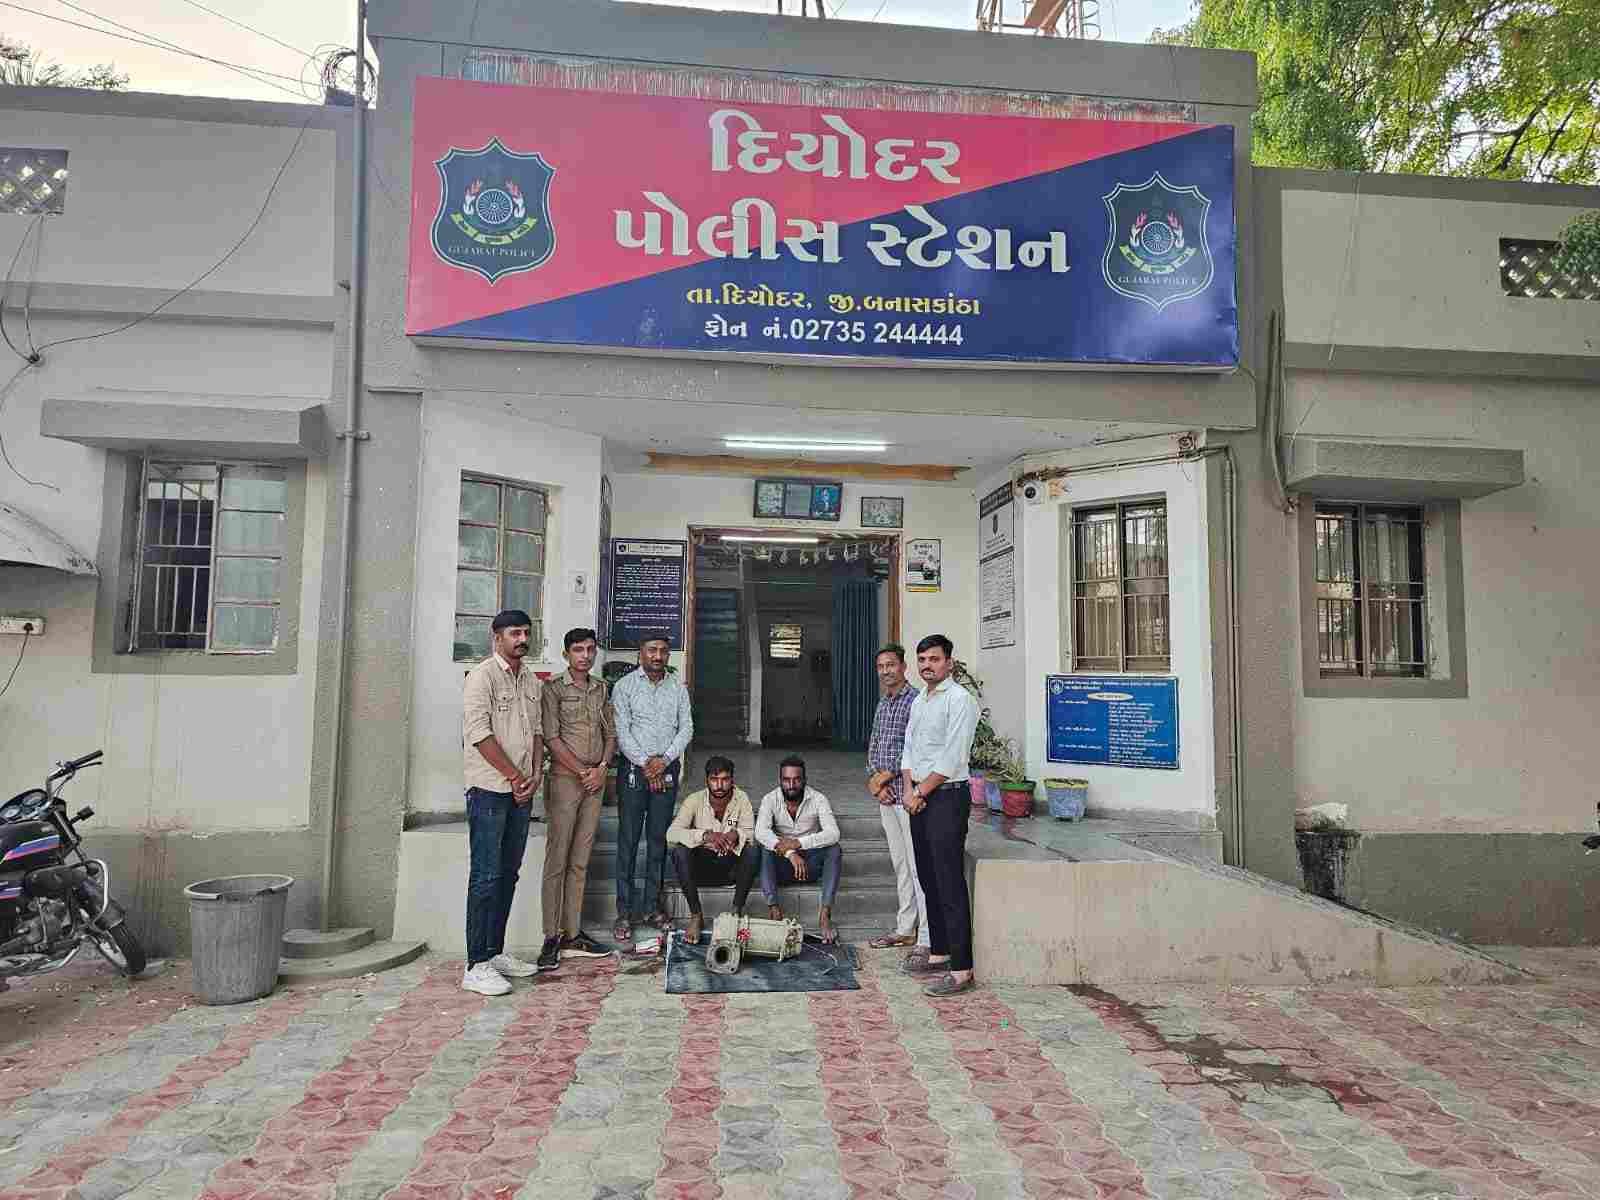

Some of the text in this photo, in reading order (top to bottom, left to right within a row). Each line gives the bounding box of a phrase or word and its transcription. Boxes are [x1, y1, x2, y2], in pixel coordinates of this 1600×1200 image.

[708, 109, 961, 184] દિયોદર
[613, 191, 847, 264] પોલીસ
[866, 205, 1072, 273] સ્ટેશન
[704, 313, 748, 339] ફોન
[873, 321, 964, 346] 244444
